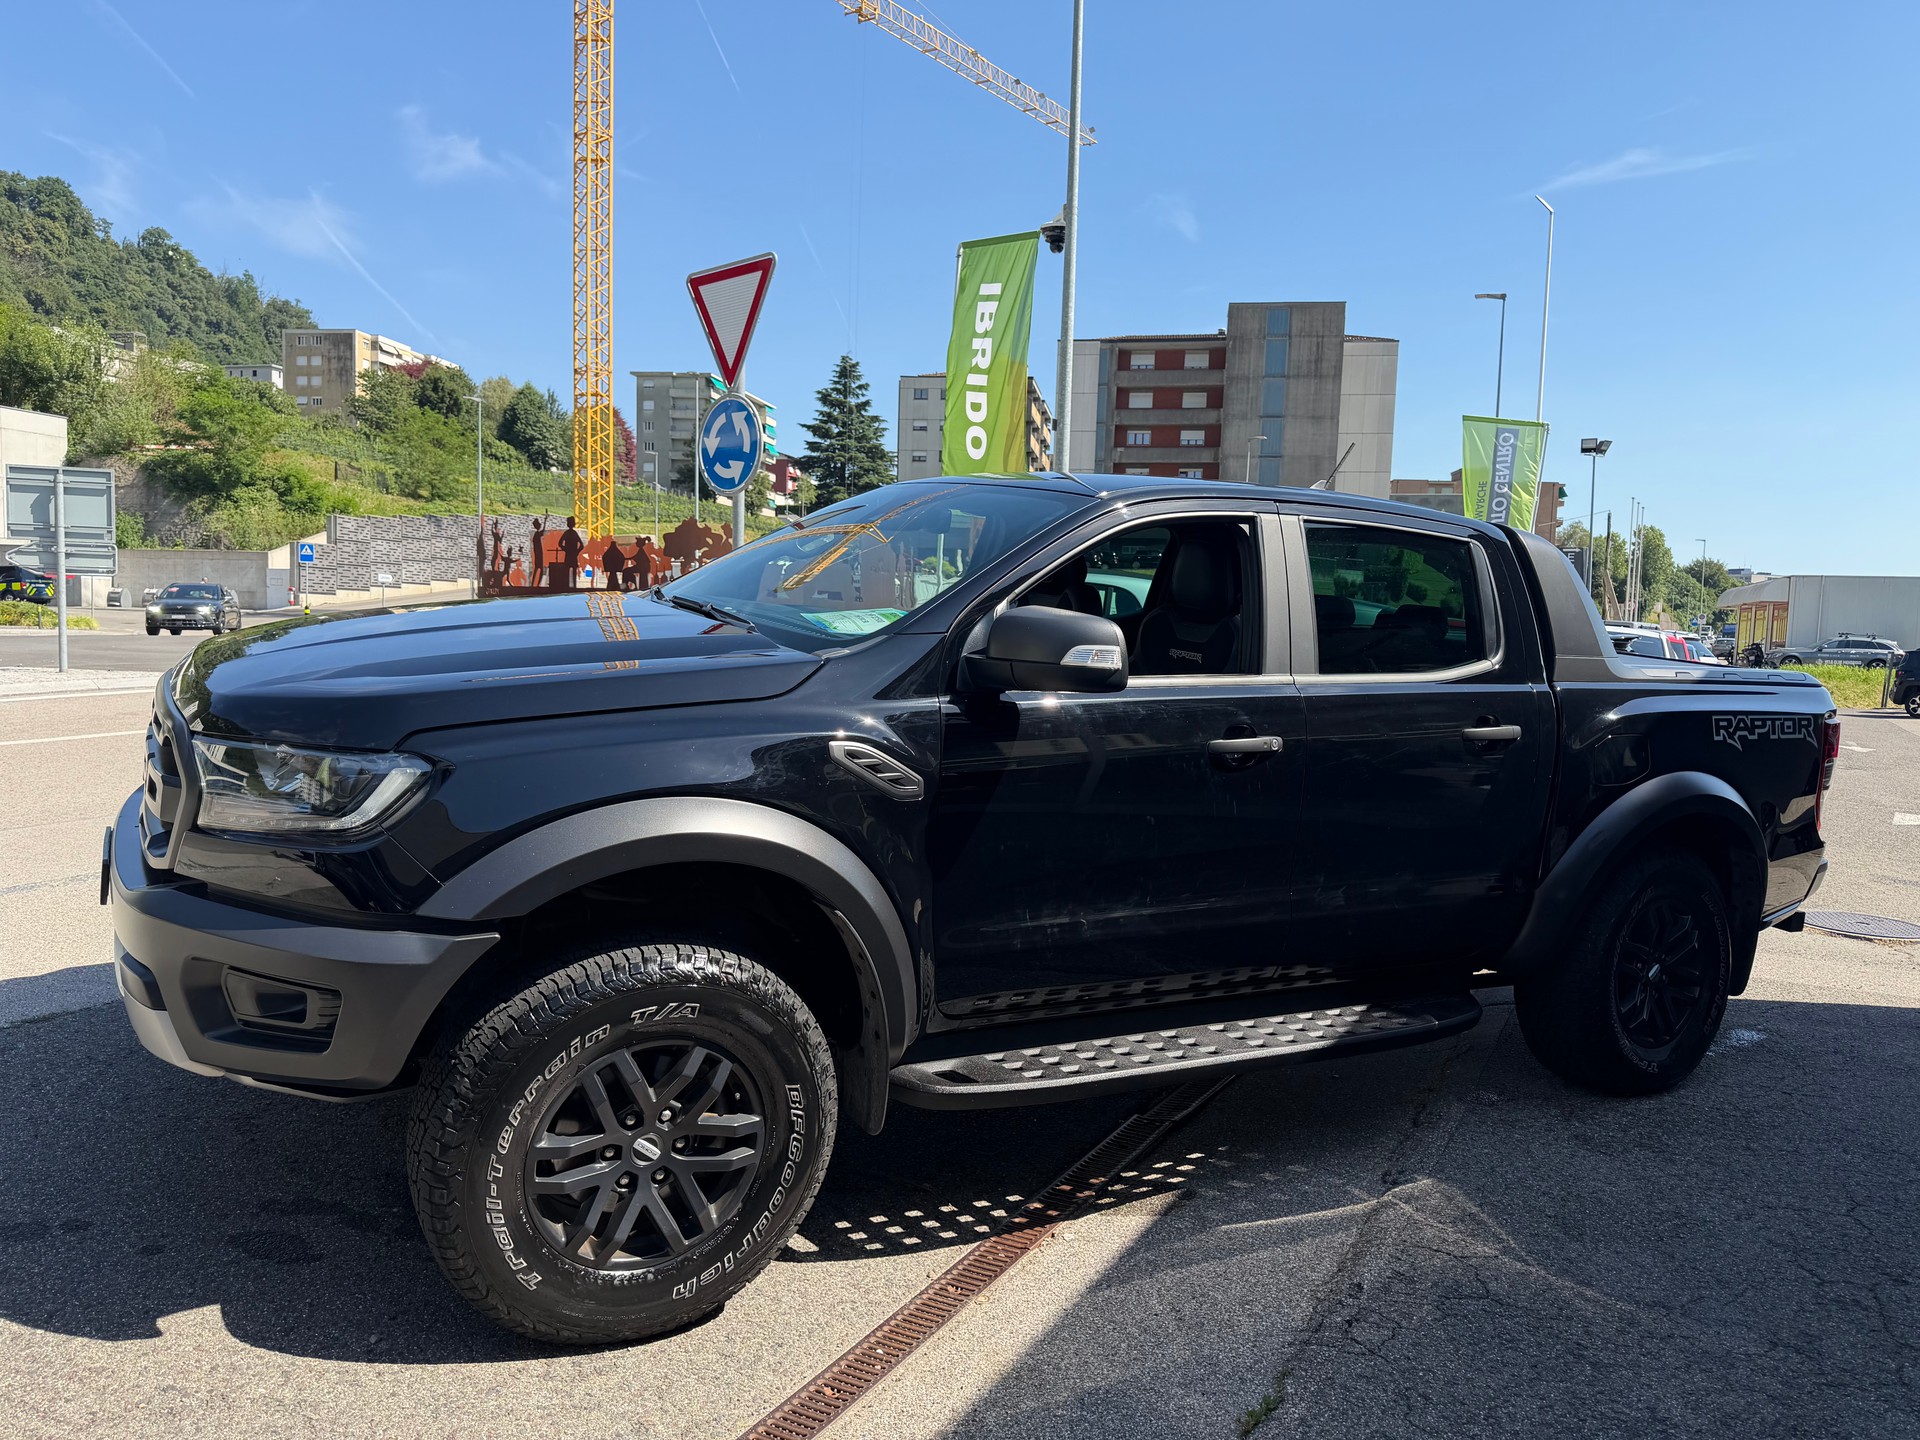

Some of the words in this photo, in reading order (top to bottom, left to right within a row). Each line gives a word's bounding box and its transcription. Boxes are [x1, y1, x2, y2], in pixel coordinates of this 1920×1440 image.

[966, 282, 1002, 460] IBRIDO
[1712, 715, 1818, 752] RAPTOR
[485, 1023, 611, 1292] Trail-Terrain
[629, 1001, 701, 1025] T/A
[672, 1083, 803, 1300] BFGoodrich
